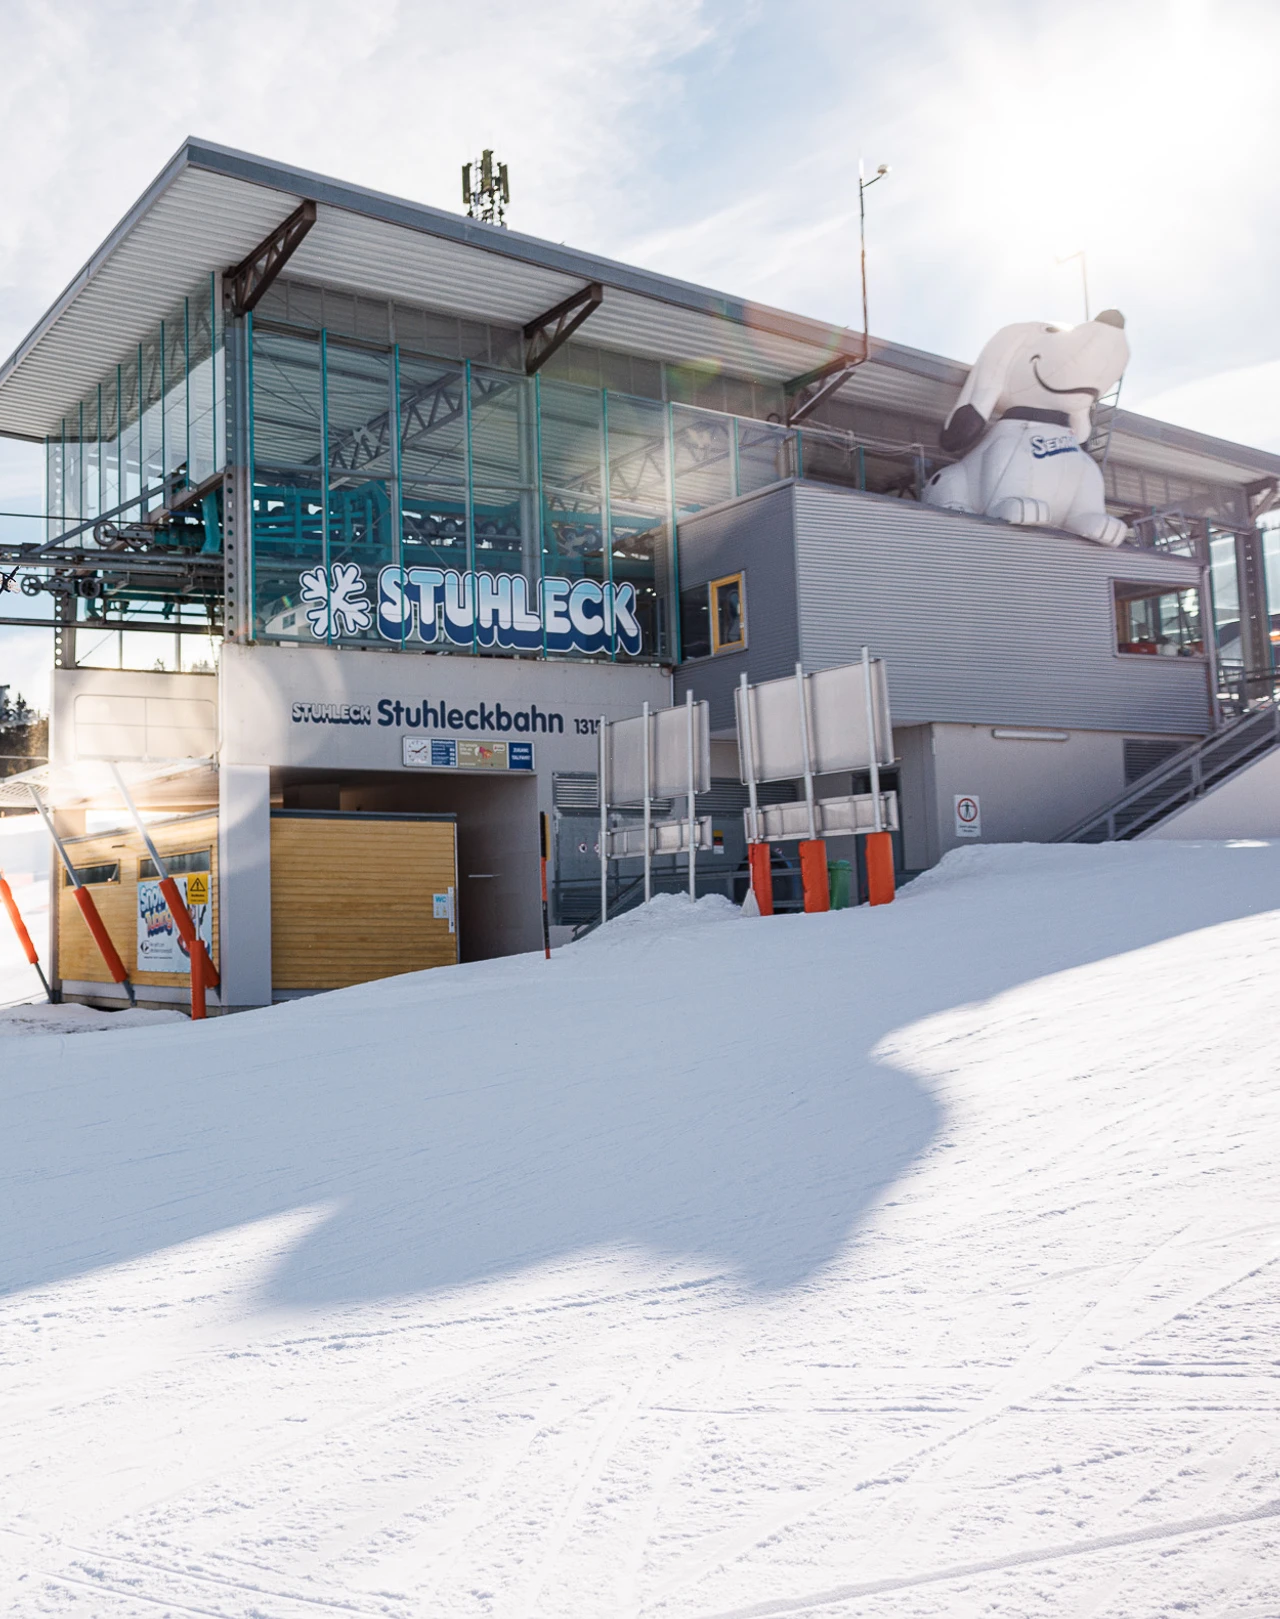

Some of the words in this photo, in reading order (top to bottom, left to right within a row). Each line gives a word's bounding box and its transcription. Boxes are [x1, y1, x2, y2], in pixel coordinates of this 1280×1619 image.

[378, 564, 642, 656] STUHLECK
[292, 702, 371, 725] STUHLECK
[377, 699, 563, 733] Stuhleckbahn
[435, 895, 446, 903] WC
